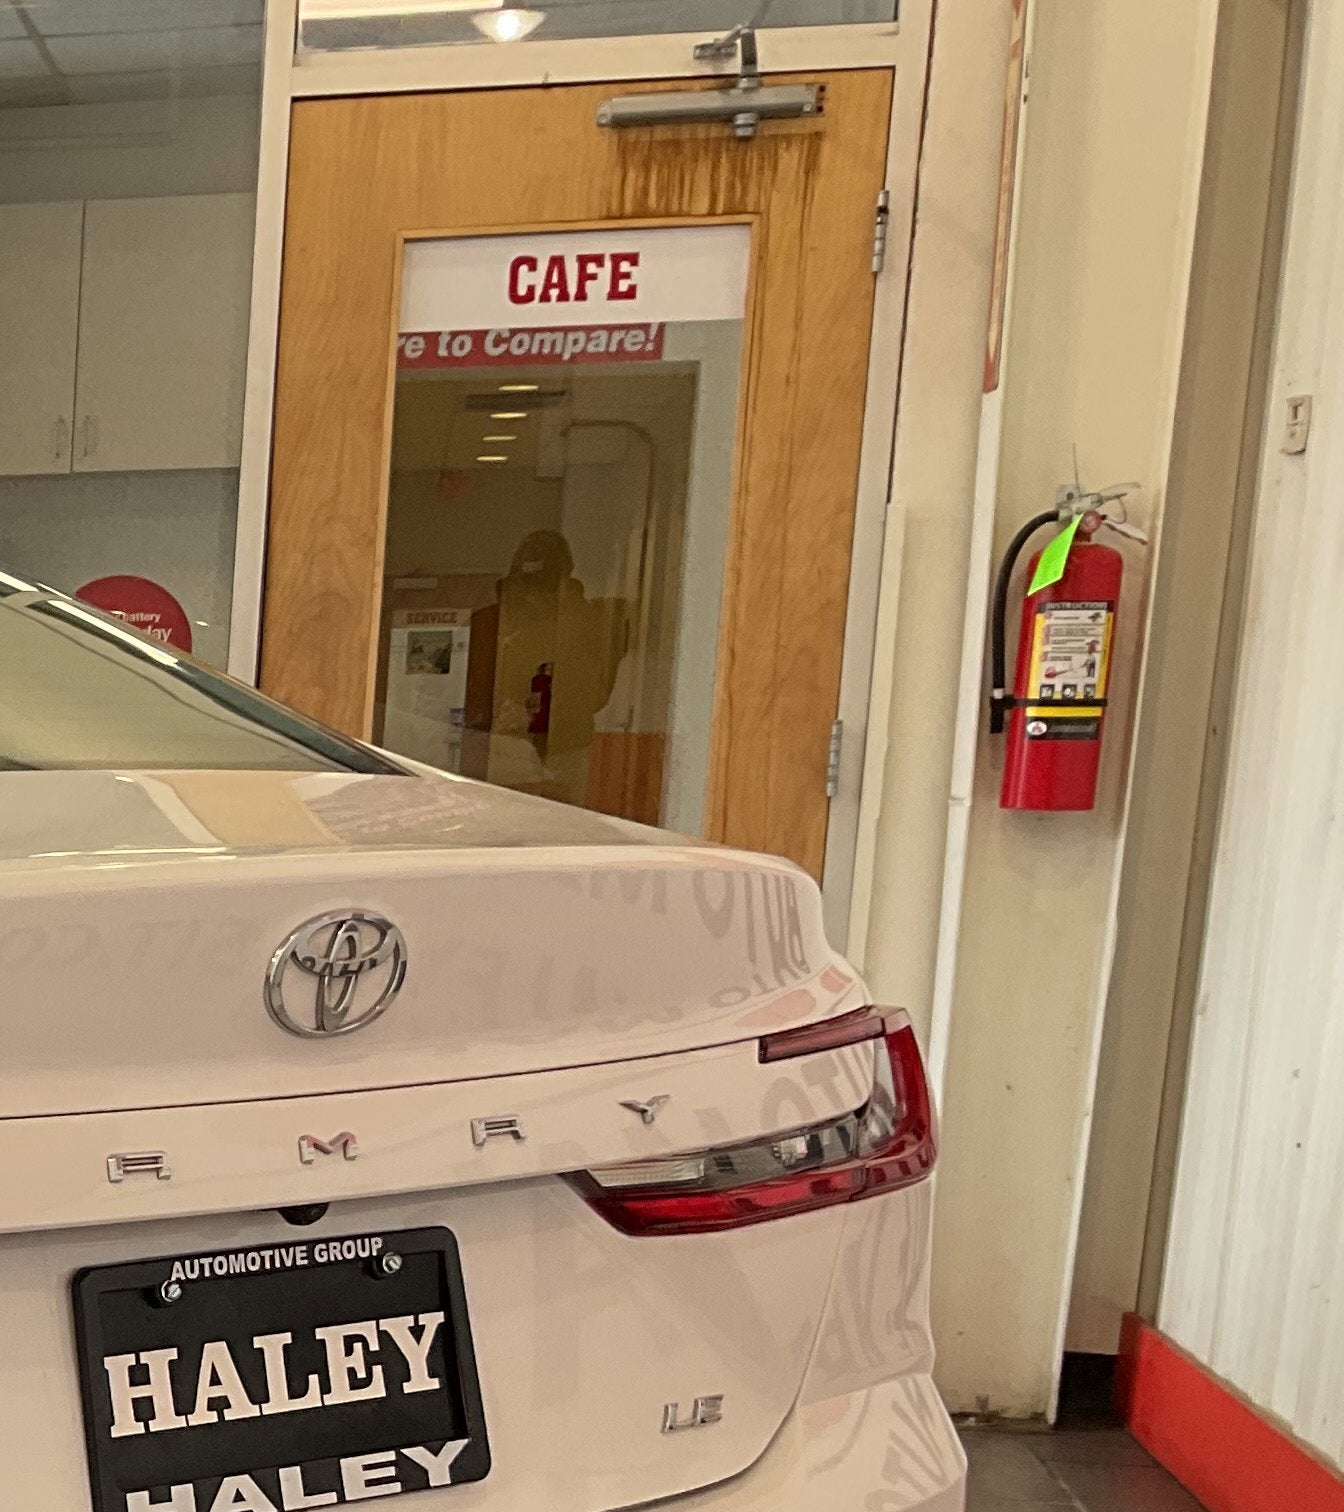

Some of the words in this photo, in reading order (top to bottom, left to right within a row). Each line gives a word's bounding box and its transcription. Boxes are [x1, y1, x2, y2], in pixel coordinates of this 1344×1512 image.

[508, 251, 641, 304] CAFE
[437, 331, 473, 358] to
[484, 322, 660, 361] Compare!
[406, 611, 457, 625] SERVICE
[170, 1245, 309, 1282] AUTOMOTIVE
[313, 1236, 384, 1263] GROUP
[103, 1310, 445, 1439] HALEY
[661, 1394, 724, 1434] LE
